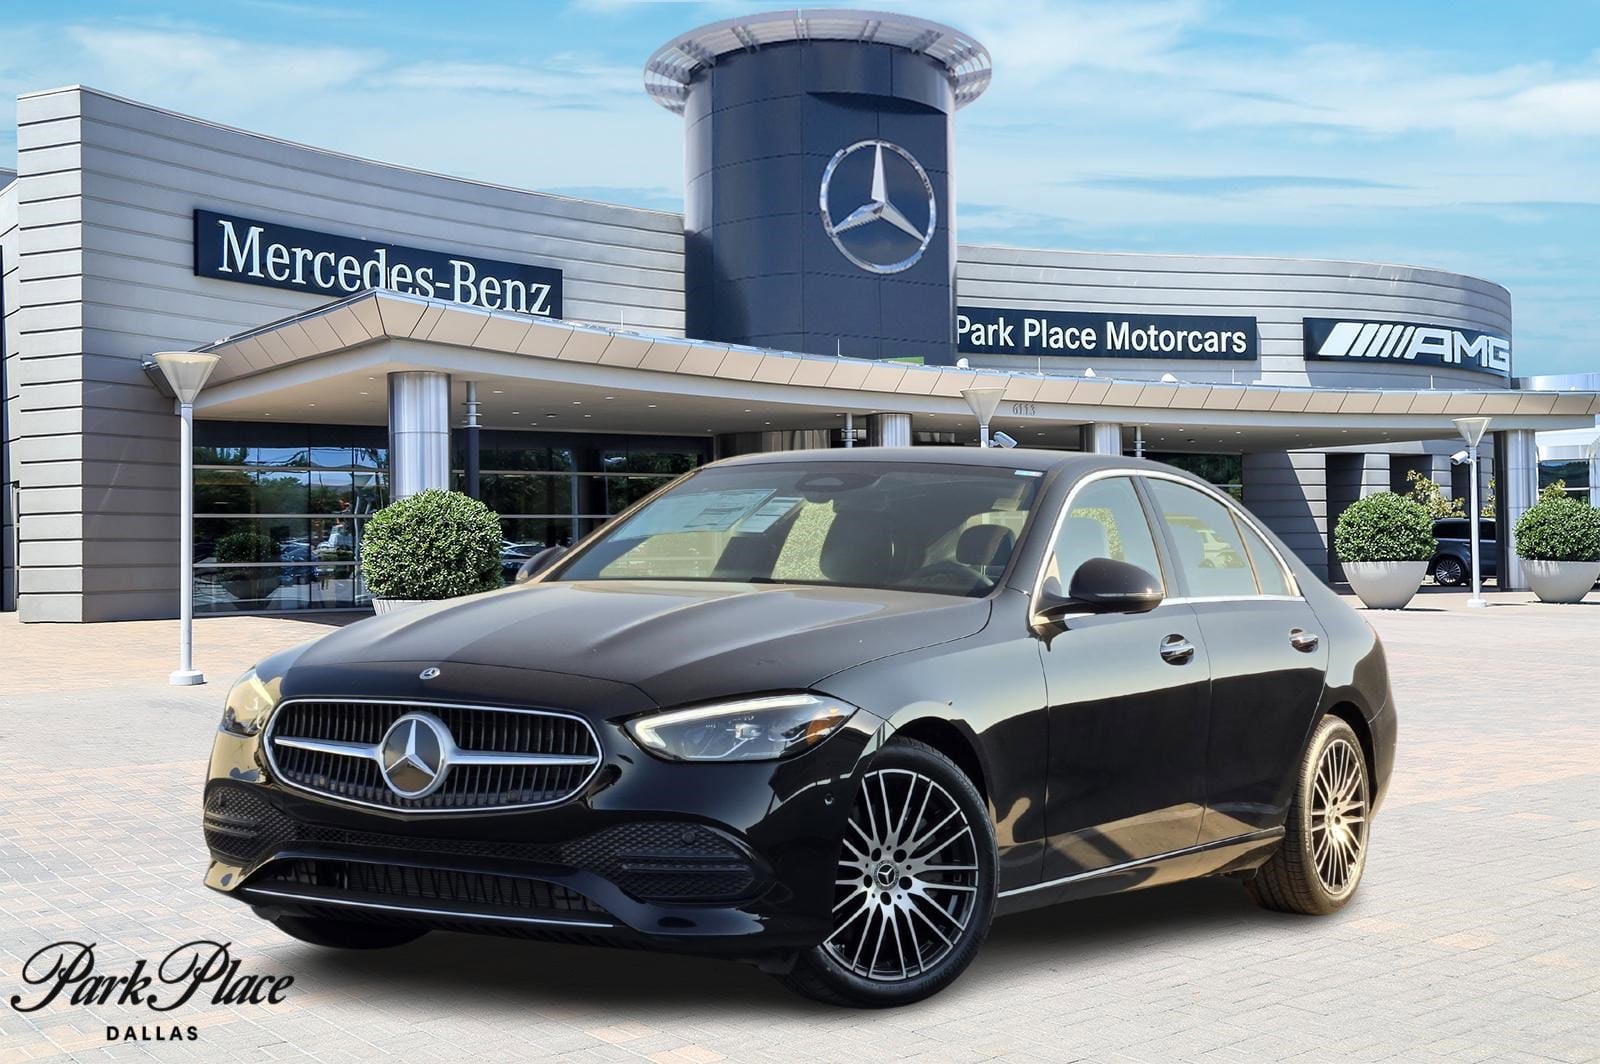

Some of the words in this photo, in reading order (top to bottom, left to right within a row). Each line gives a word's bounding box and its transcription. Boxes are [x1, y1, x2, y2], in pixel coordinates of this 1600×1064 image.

[217, 219, 552, 316] Mercedes-Benz
[956, 315, 1014, 347] Park
[1023, 318, 1097, 350] Place
[1106, 321, 1248, 353] Motorcars
